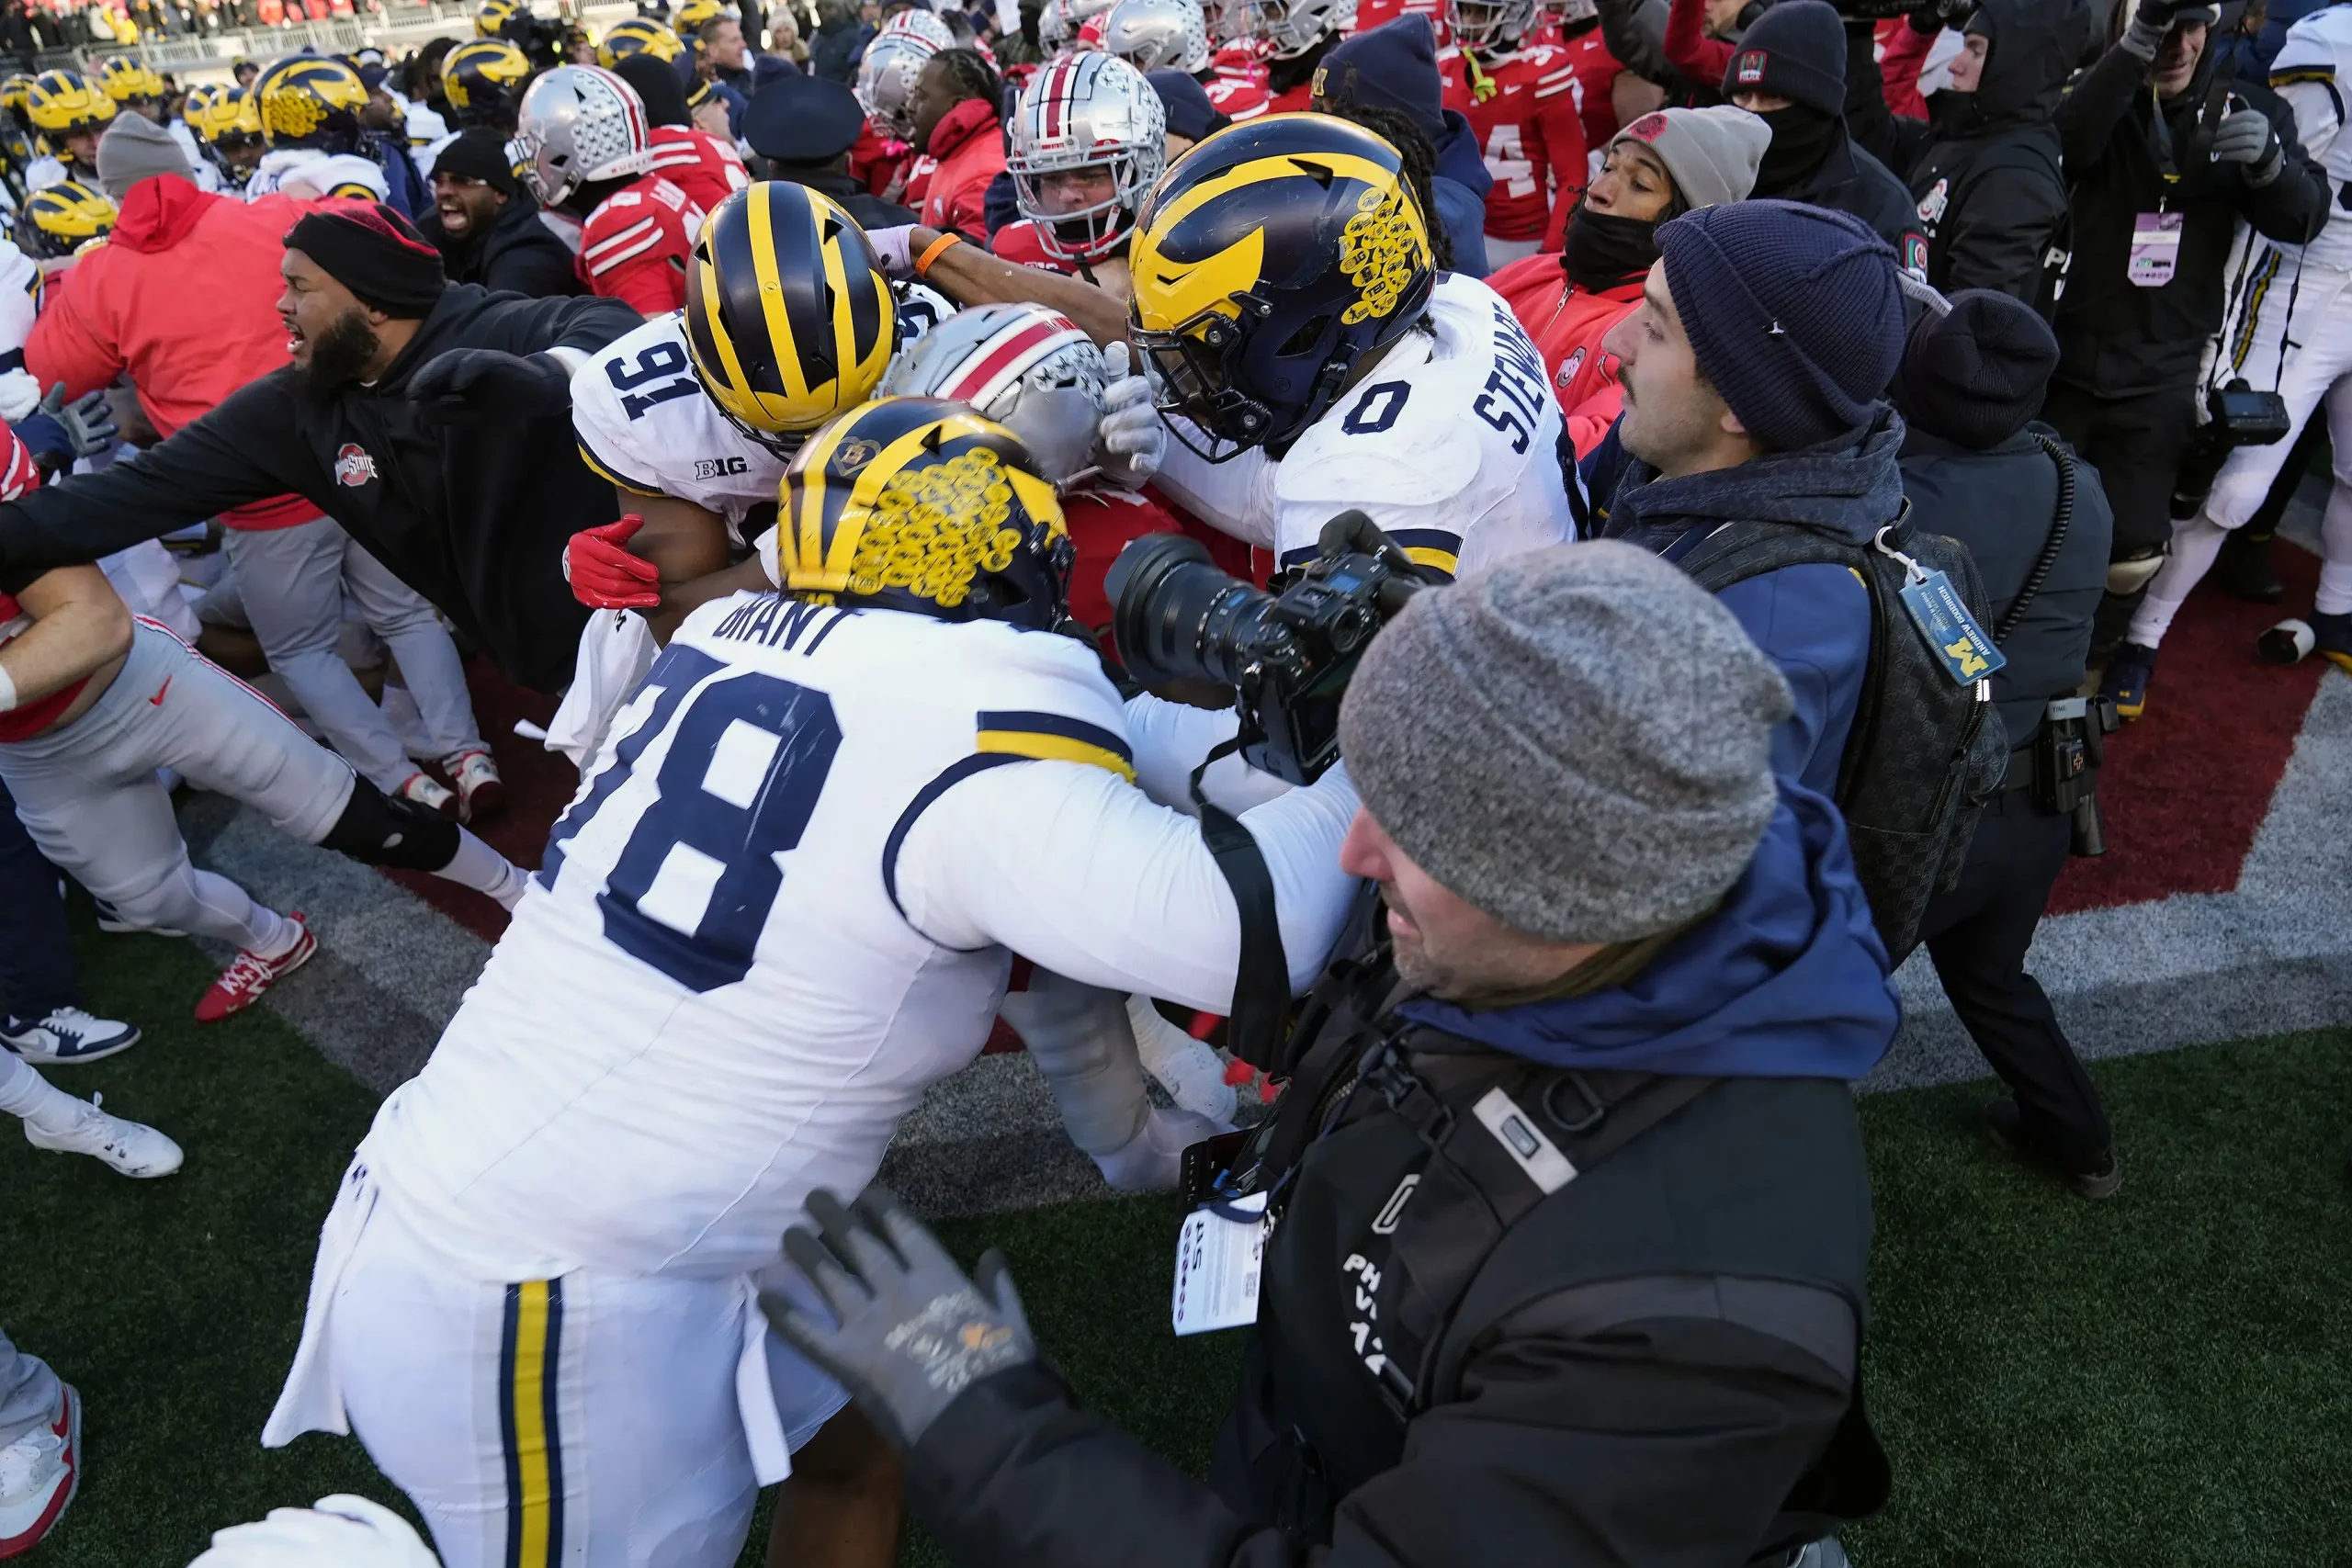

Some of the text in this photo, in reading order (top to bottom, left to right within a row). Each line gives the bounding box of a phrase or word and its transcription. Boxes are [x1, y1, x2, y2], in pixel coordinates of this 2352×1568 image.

[1483, 123, 1536, 198] 4
[1365, 280, 1386, 298] TED
[605, 341, 702, 422] 91
[1937, 585, 1991, 657] ANDREW GOODRICH
[537, 642, 844, 995] 78
